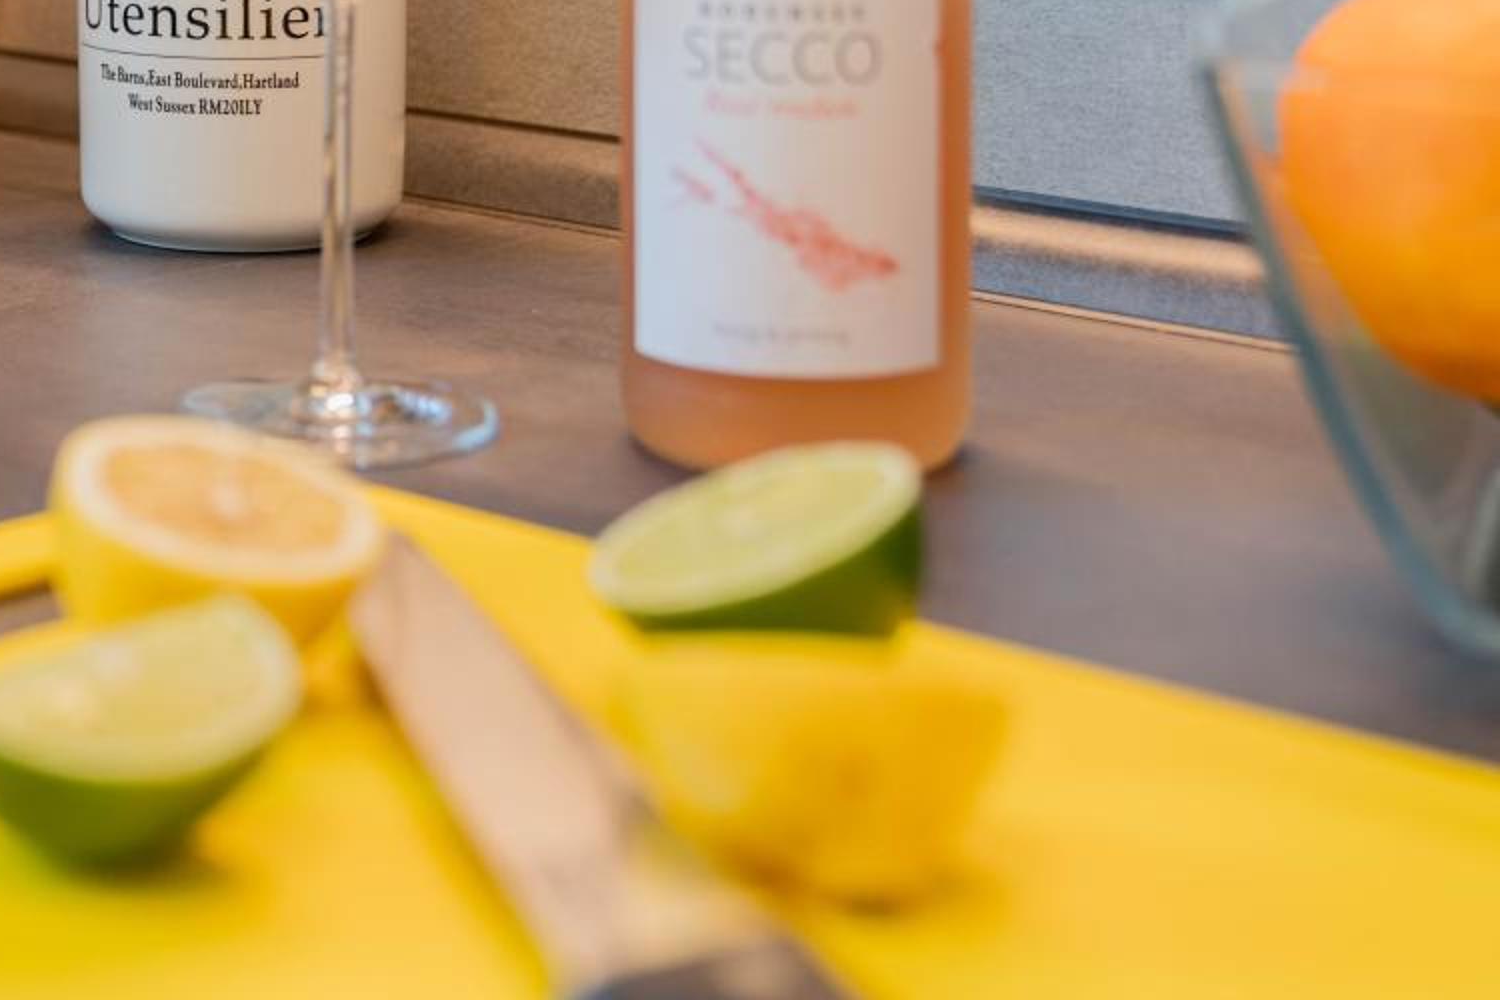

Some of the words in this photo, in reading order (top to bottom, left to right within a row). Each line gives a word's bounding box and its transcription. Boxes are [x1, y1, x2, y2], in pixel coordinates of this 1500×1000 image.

[682, 26, 884, 88] SECCO
[100, 63, 116, 82] The
[128, 92, 153, 113] West
[155, 97, 196, 115] Sussex
